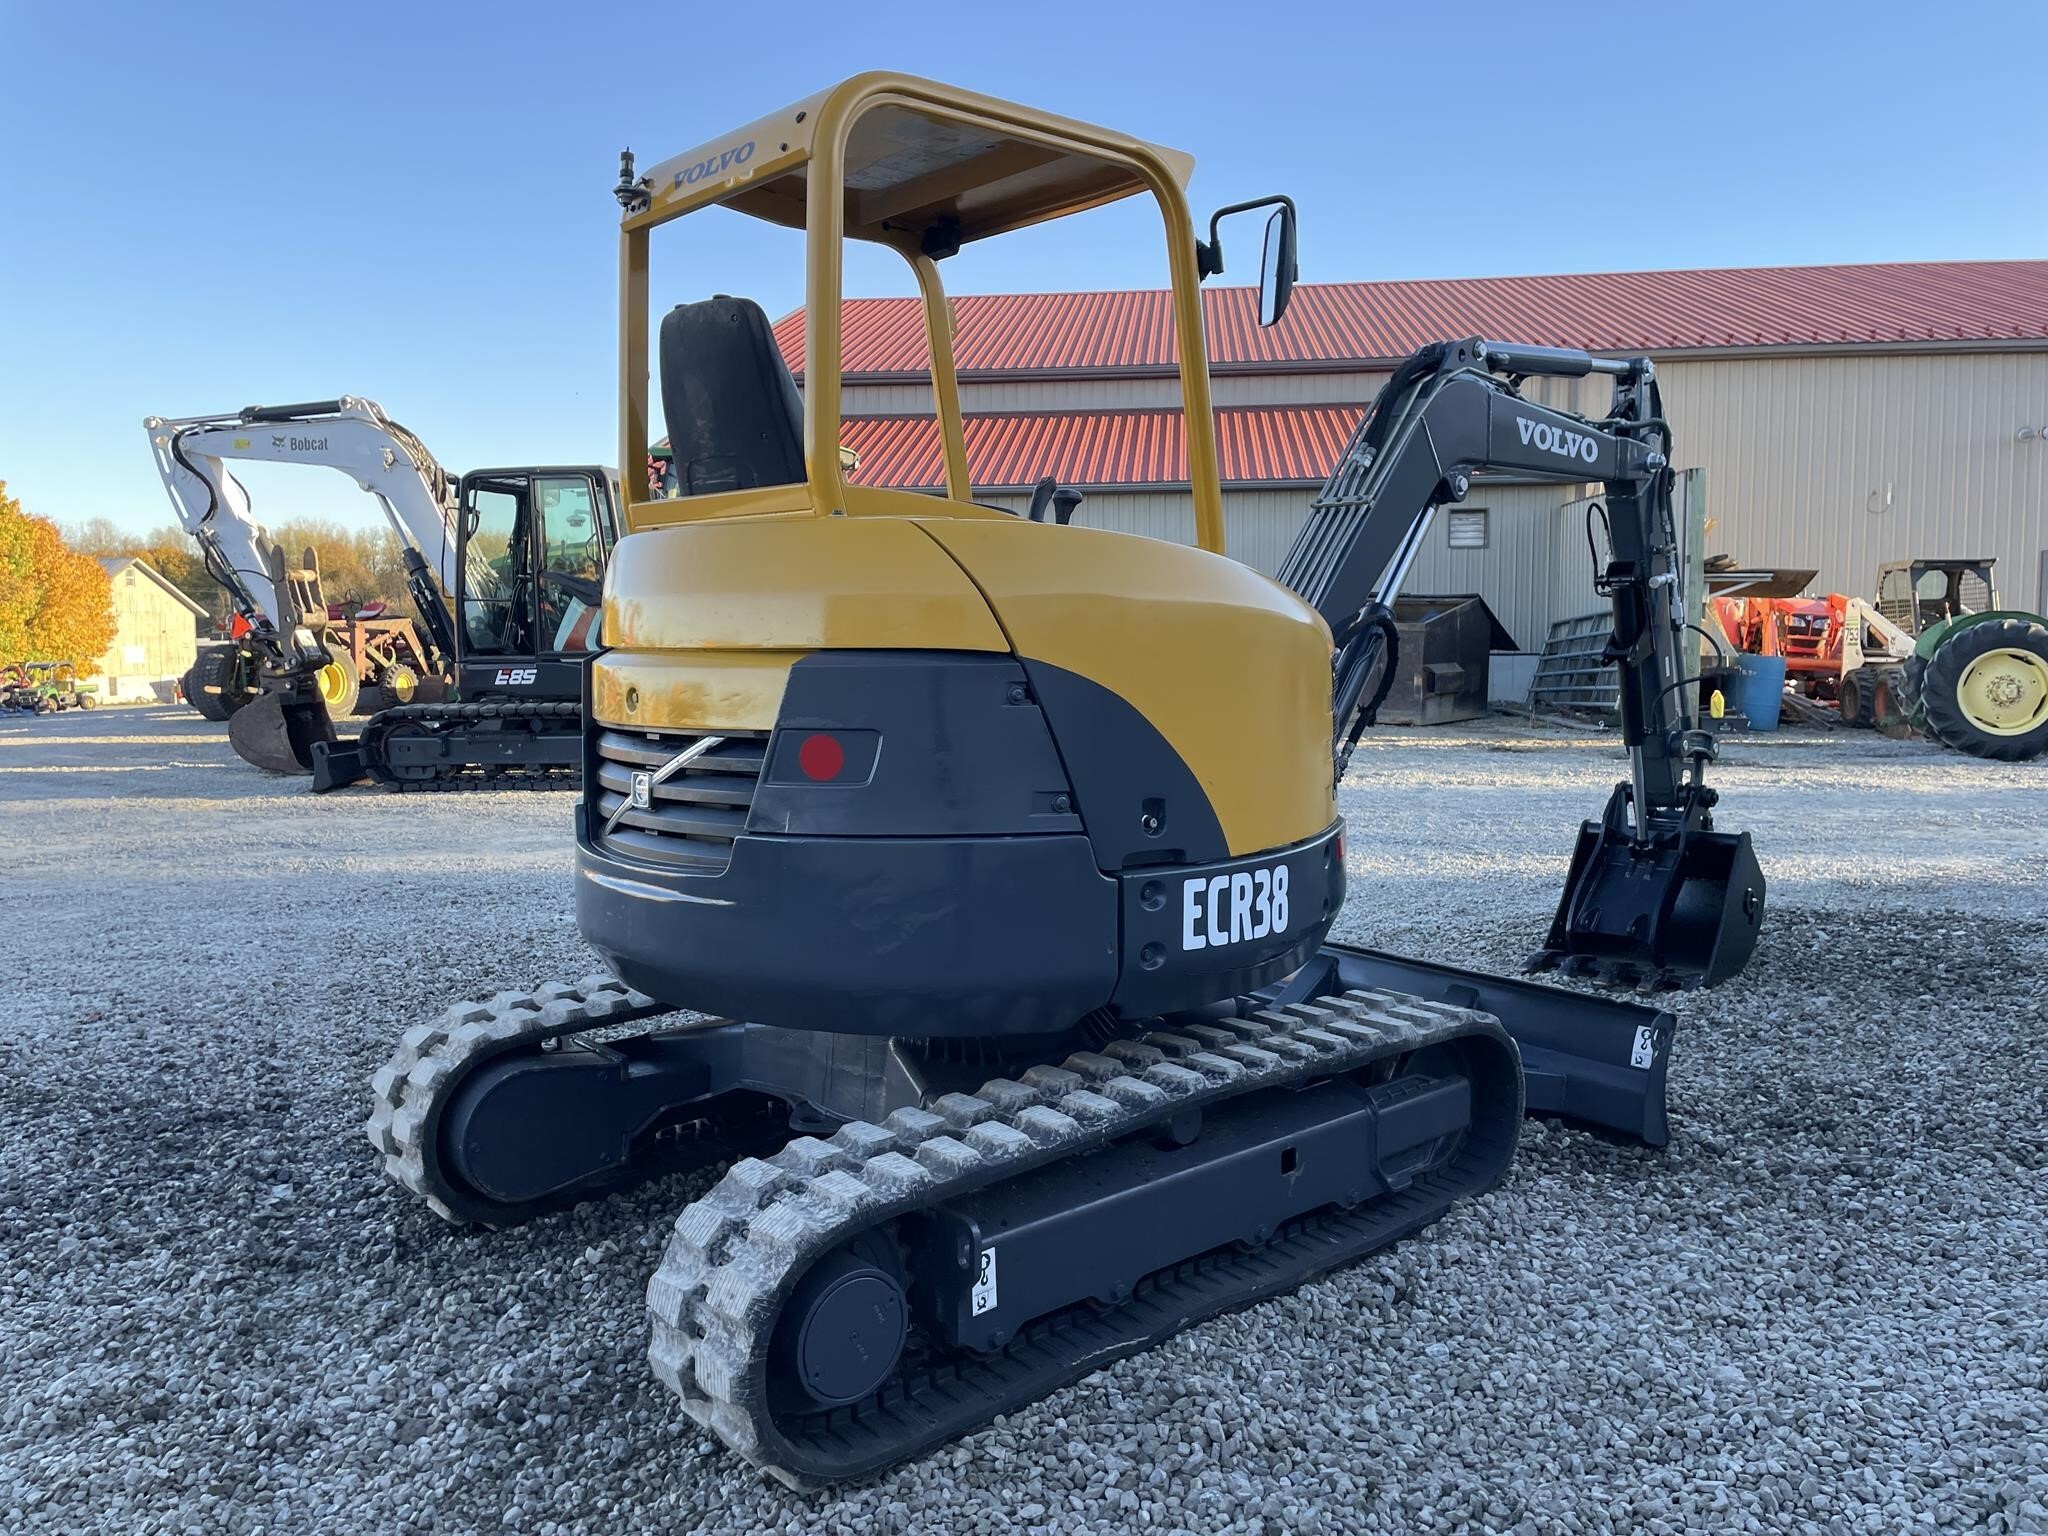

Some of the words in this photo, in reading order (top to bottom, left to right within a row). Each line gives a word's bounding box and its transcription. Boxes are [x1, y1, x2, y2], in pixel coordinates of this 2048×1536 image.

[674, 141, 756, 190] VOLVO
[290, 437, 329, 452] Bobcat
[1516, 416, 1599, 463] VOLVO
[1845, 627, 1859, 641] 753
[494, 668, 538, 685] E85
[1182, 864, 1289, 951] ECR38
